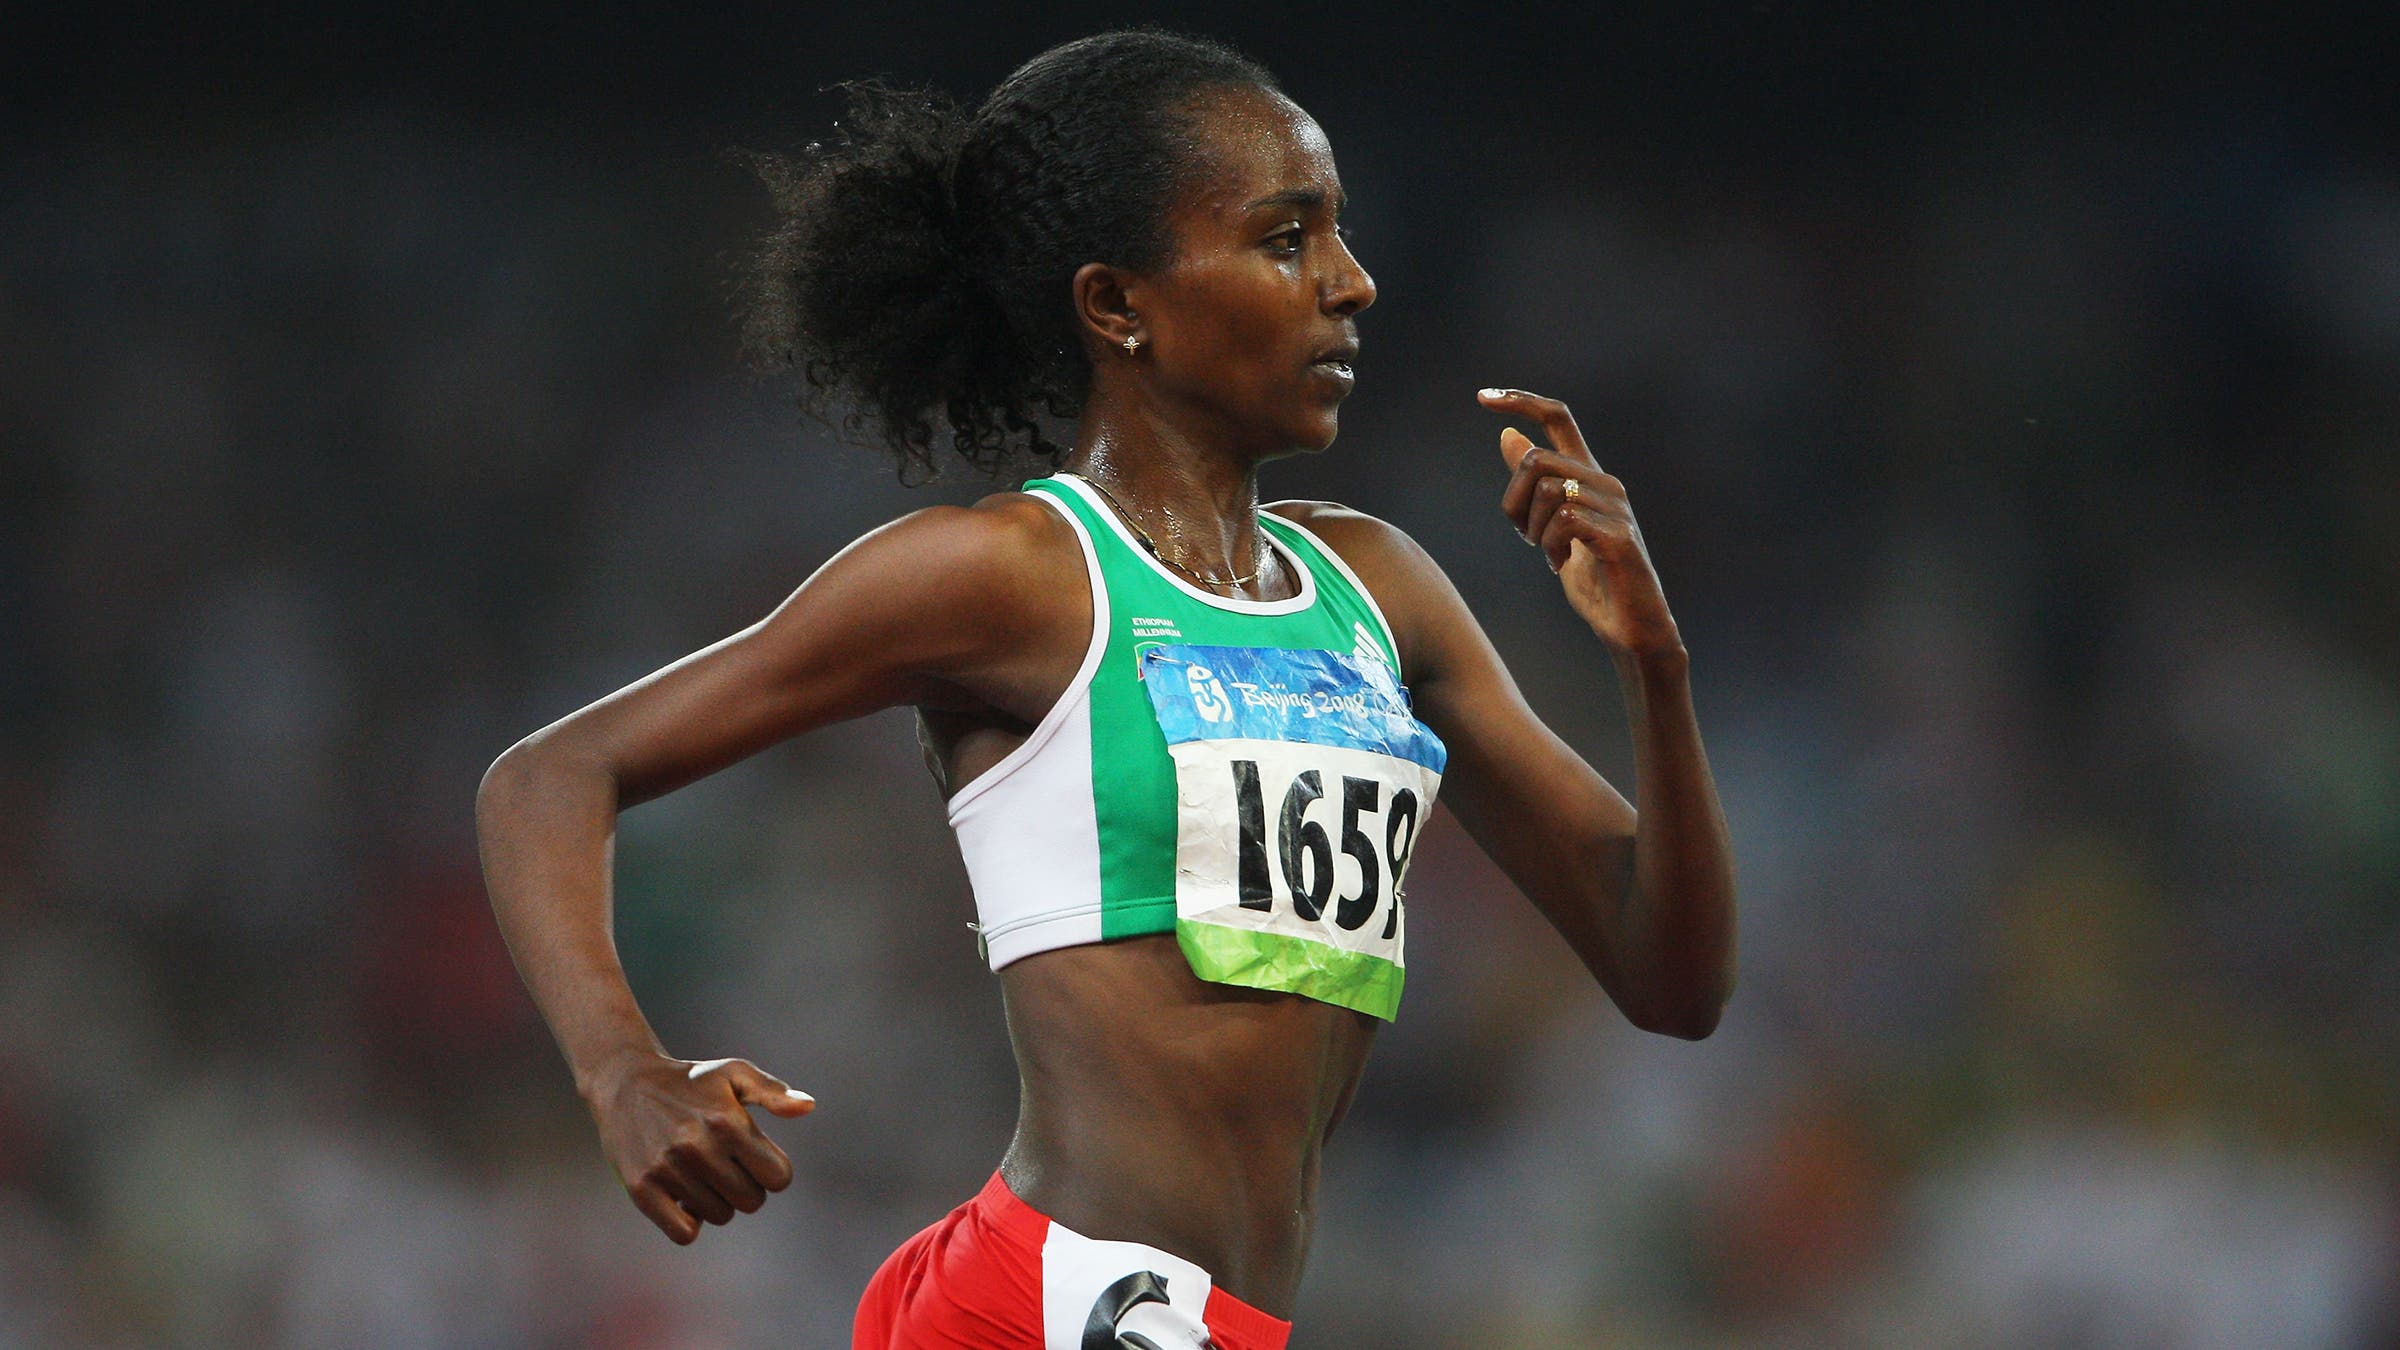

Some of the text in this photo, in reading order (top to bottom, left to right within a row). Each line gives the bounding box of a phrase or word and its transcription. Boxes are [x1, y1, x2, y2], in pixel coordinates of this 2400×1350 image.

[1132, 617, 1174, 627] ETHIOPIAN
[1132, 628, 1182, 637] MILLENNIUM
[1231, 682, 1369, 719] Beijing 2008
[1230, 760, 1418, 939] 1659
